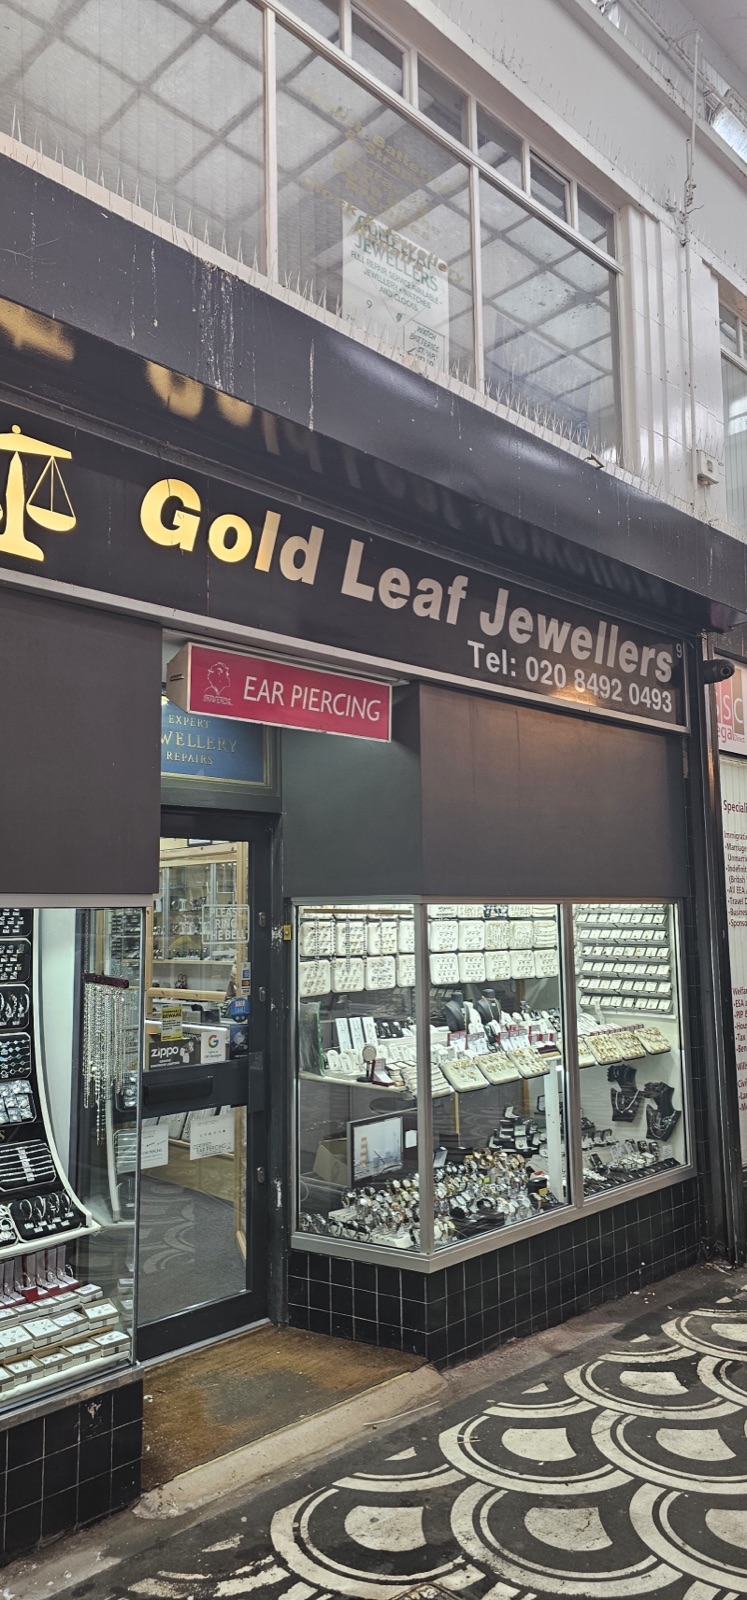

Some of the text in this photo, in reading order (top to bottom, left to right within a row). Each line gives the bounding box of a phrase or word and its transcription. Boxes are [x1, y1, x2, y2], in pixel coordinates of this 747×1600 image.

[354, 232, 438, 292] JEWELLERS
[140, 478, 673, 684] Gold Leaf Jewellers
[676, 643, 683, 659] 9
[467, 640, 672, 713] Tel: 020 8492 0493
[243, 675, 382, 722] EAR PIERCING
[168, 714, 211, 729] EXPERT
[166, 751, 213, 766] REPAIRS
[225, 929, 247, 940] BELL
[150, 1045, 179, 1058] zippo
